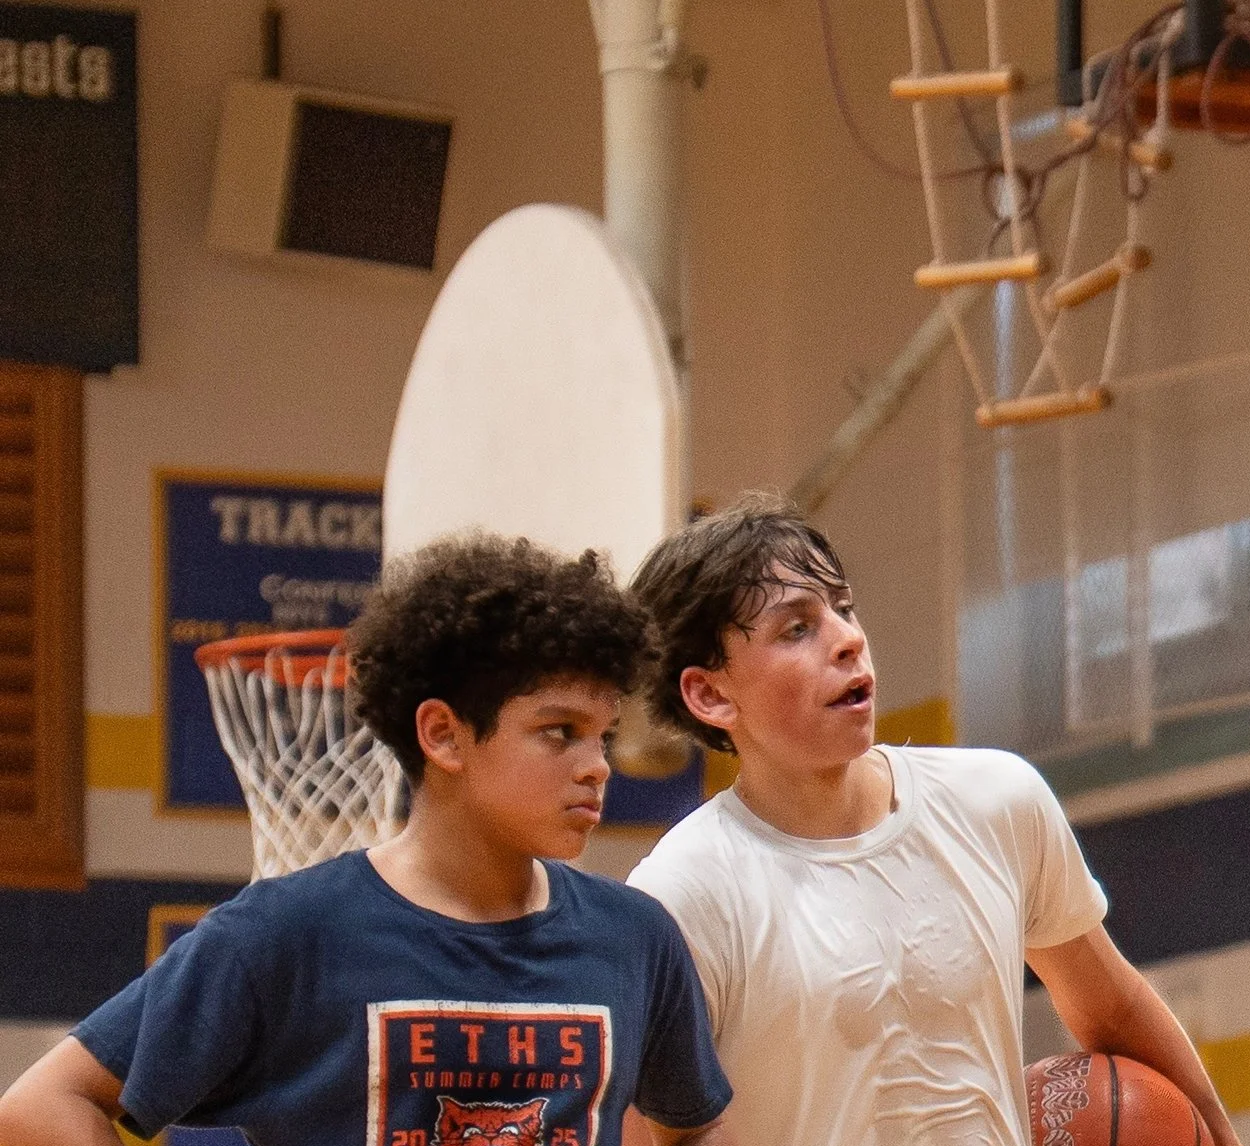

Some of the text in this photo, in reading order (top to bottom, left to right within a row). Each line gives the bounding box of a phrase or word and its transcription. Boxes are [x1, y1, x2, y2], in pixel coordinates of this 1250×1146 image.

[210, 497, 382, 549] TRACK
[410, 1023, 584, 1066] ETHS
[410, 1071, 584, 1089] SUMMER CAMPS
